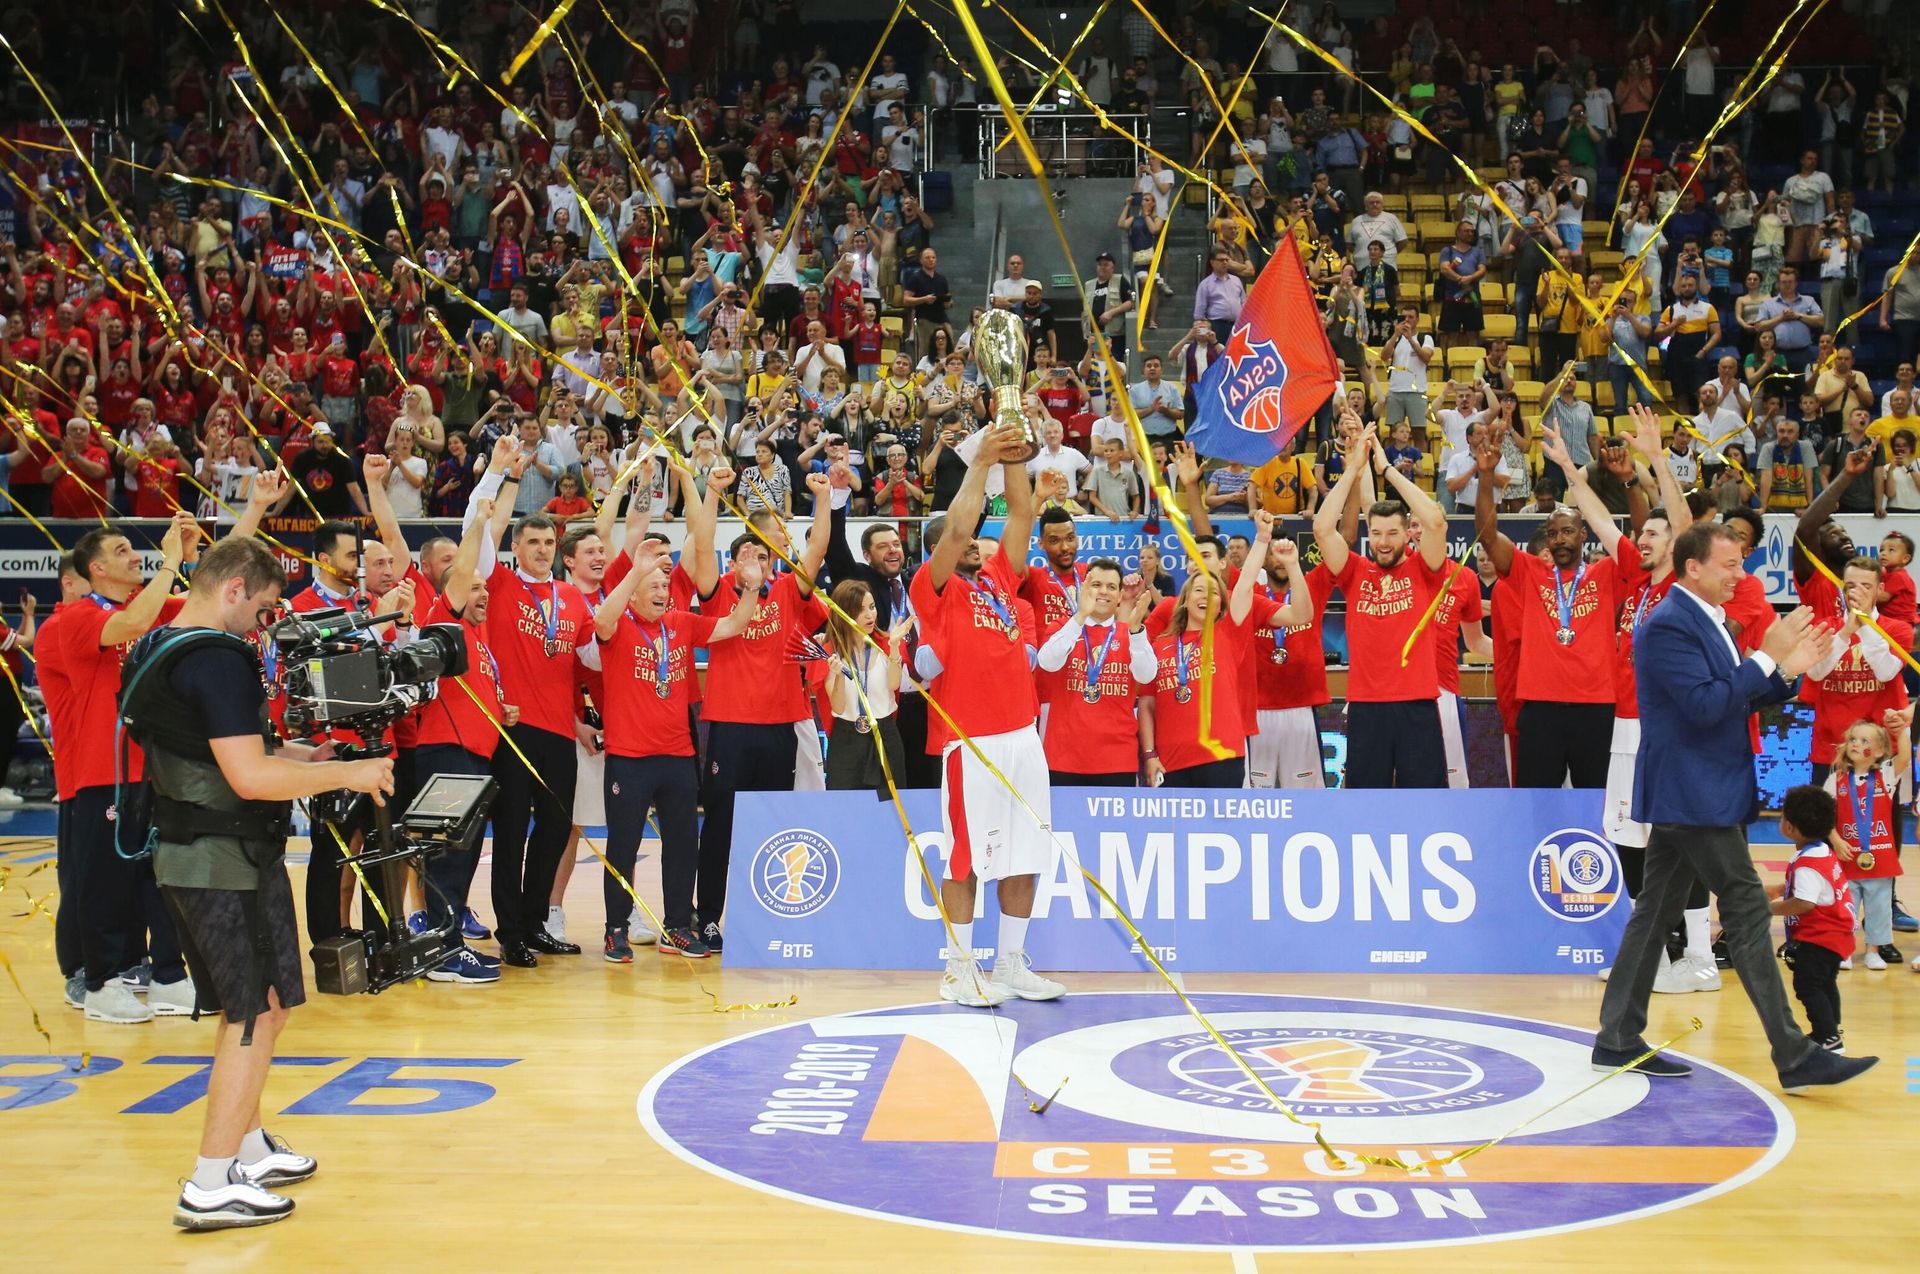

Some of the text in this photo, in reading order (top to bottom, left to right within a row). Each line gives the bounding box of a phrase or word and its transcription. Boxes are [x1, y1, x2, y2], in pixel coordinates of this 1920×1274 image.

[1676, 465, 1689, 477] 23
[1356, 596, 1414, 617] CHAMPIONS
[1087, 797, 1293, 819] VTB UNITED LEAGUE
[765, 833, 830, 855] ЕДИНАЯ ЛИГА ВТБ
[904, 831, 1477, 923] CAMPIONS
[762, 892, 827, 913] VTB UNITED LEAGUE
[1563, 904, 1595, 913] SEASON
[782, 943, 814, 958] ВТБ
[1369, 950, 1427, 963] СИБУР
[1572, 949, 1605, 964] ВТБ
[1308, 1030, 1398, 1041] ЛИГА
[1407, 1039, 1468, 1051] ВТБ
[749, 1043, 880, 1135] 2018-2019
[1176, 1088, 1235, 1104] VTB
[1389, 1089, 1505, 1113] LEAGUE
[1027, 1183, 1488, 1219] SEASON
